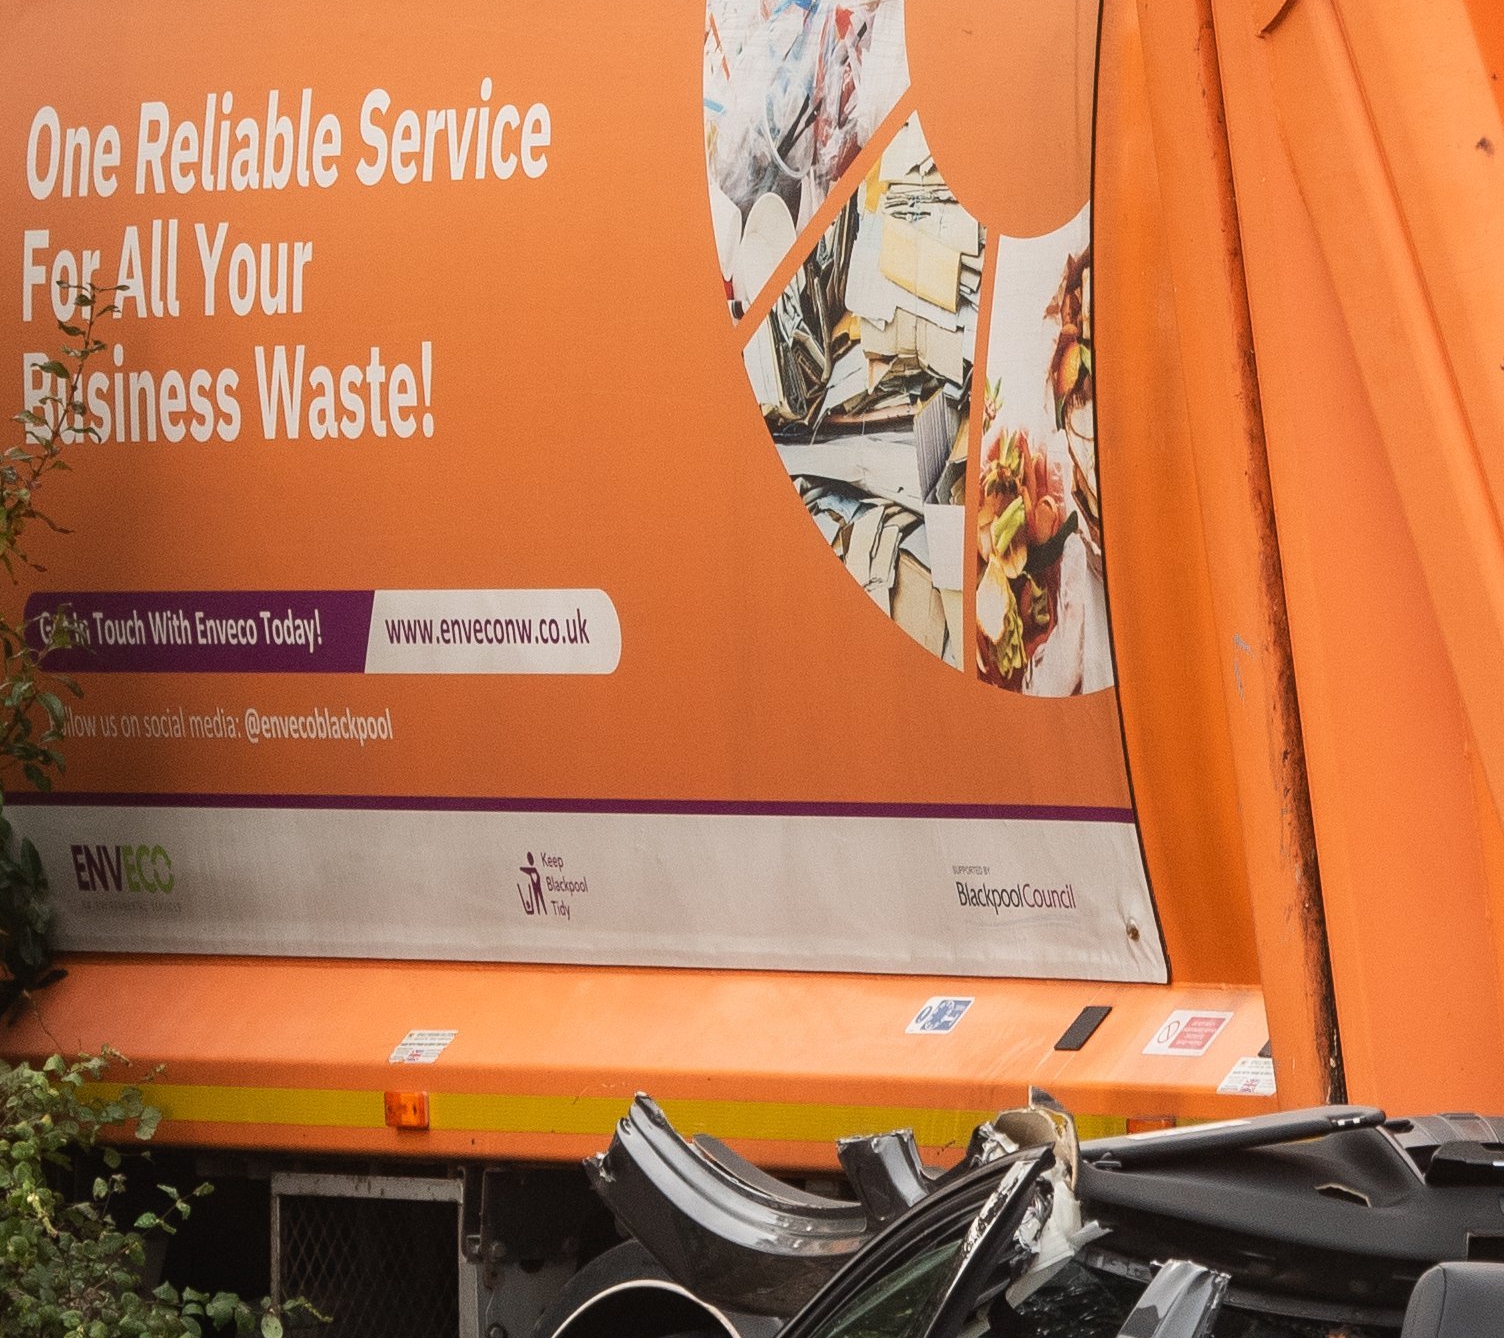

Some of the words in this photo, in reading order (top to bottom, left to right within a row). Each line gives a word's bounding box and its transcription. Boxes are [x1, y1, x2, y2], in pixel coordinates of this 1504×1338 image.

[27, 106, 121, 200] One
[136, 88, 342, 195] Reliable
[356, 77, 552, 186] Service
[23, 229, 100, 322] For
[113, 218, 179, 319] All
[195, 222, 313, 317] Your
[23, 343, 242, 444] Business
[255, 341, 435, 440] Waste!
[93, 610, 146, 645] Touch
[148, 609, 194, 645] With
[195, 611, 258, 645] Enveco
[259, 609, 323, 654] Today!
[385, 609, 590, 646] www.enveconw.co.uk
[49, 706, 96, 738] llow
[99, 714, 118, 738] us
[120, 714, 141, 738] on
[143, 707, 187, 739] social
[189, 707, 241, 740] media:
[245, 707, 394, 747] @envecoblackpool
[70, 843, 175, 895] ENVECO
[540, 852, 564, 872] Keep
[952, 865, 983, 876] SUPPORTED
[545, 875, 589, 897] Blackpool
[550, 900, 571, 921] Tidy
